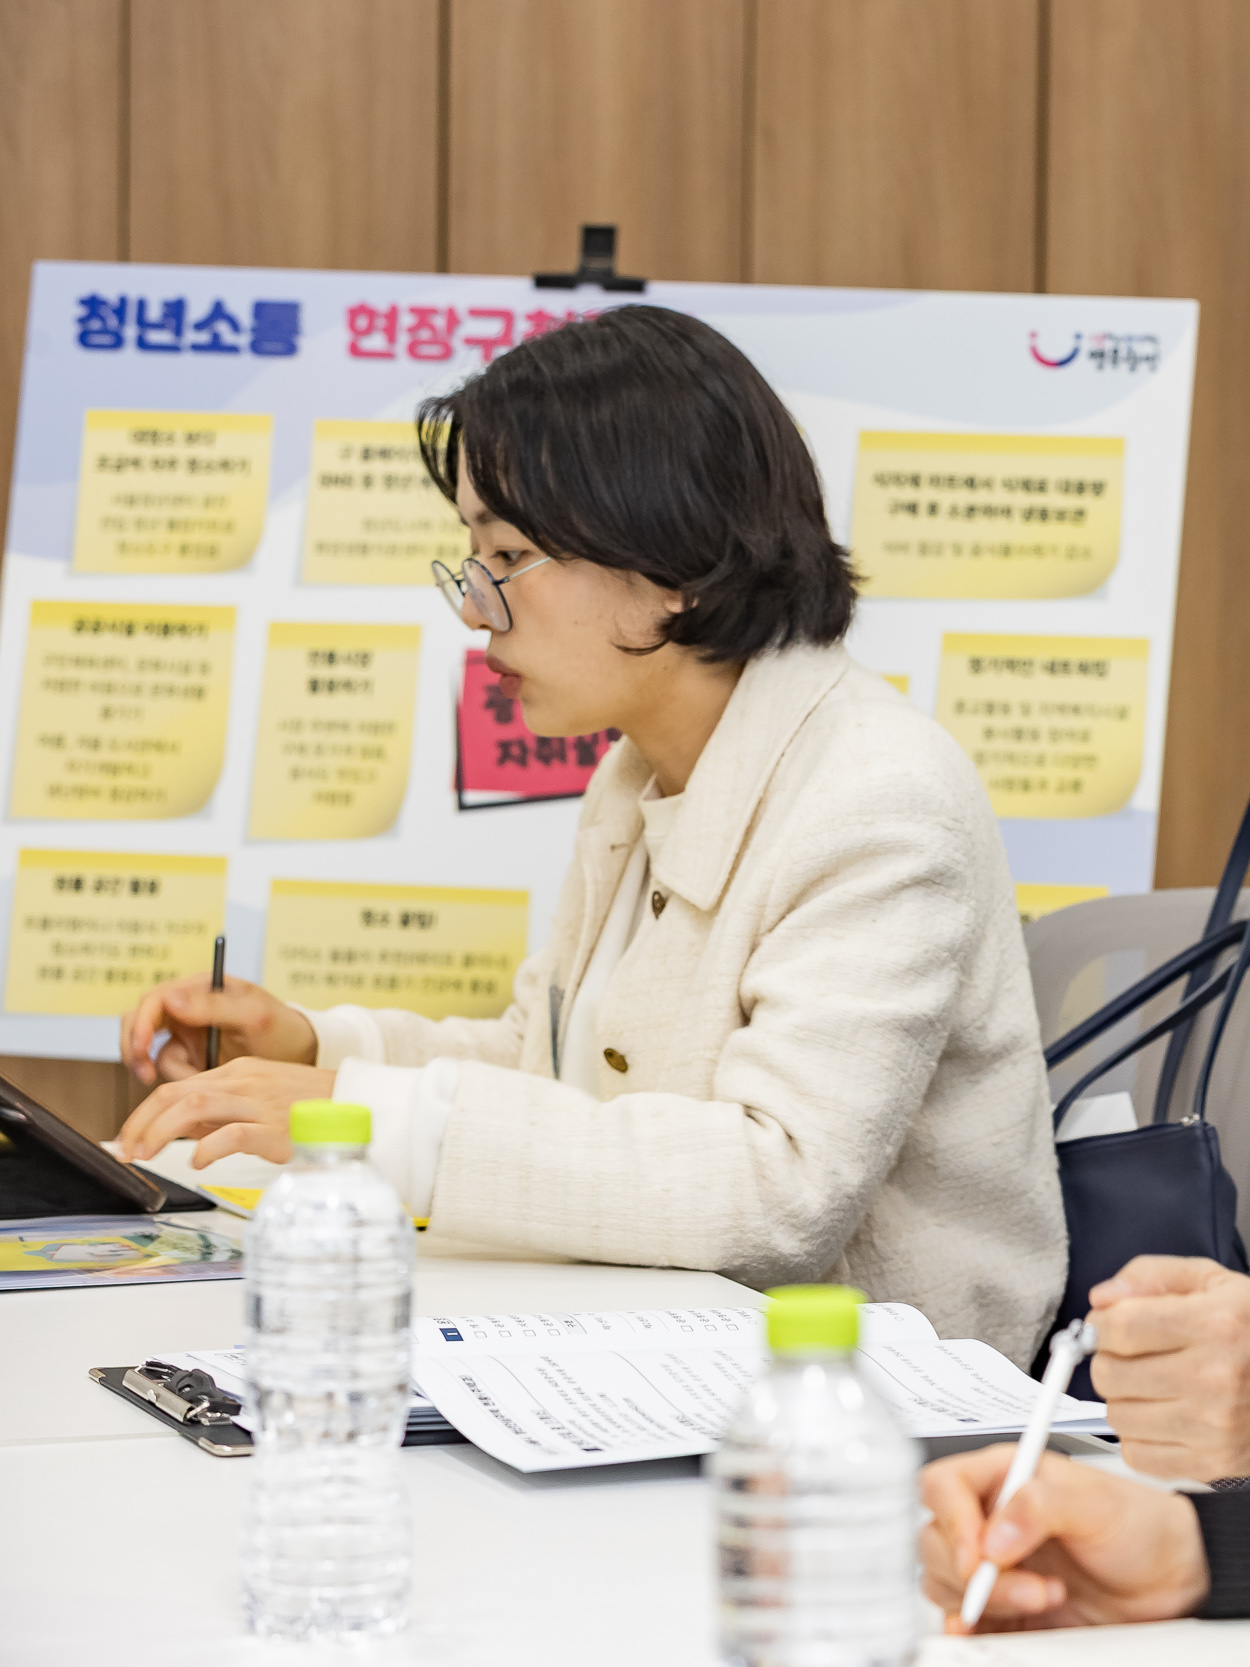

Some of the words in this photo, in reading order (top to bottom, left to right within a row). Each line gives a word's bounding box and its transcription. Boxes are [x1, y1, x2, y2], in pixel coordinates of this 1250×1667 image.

[75, 293, 301, 357] 청년소통
[346, 303, 598, 362] 현장구
[498, 727, 622, 767] 자취생
